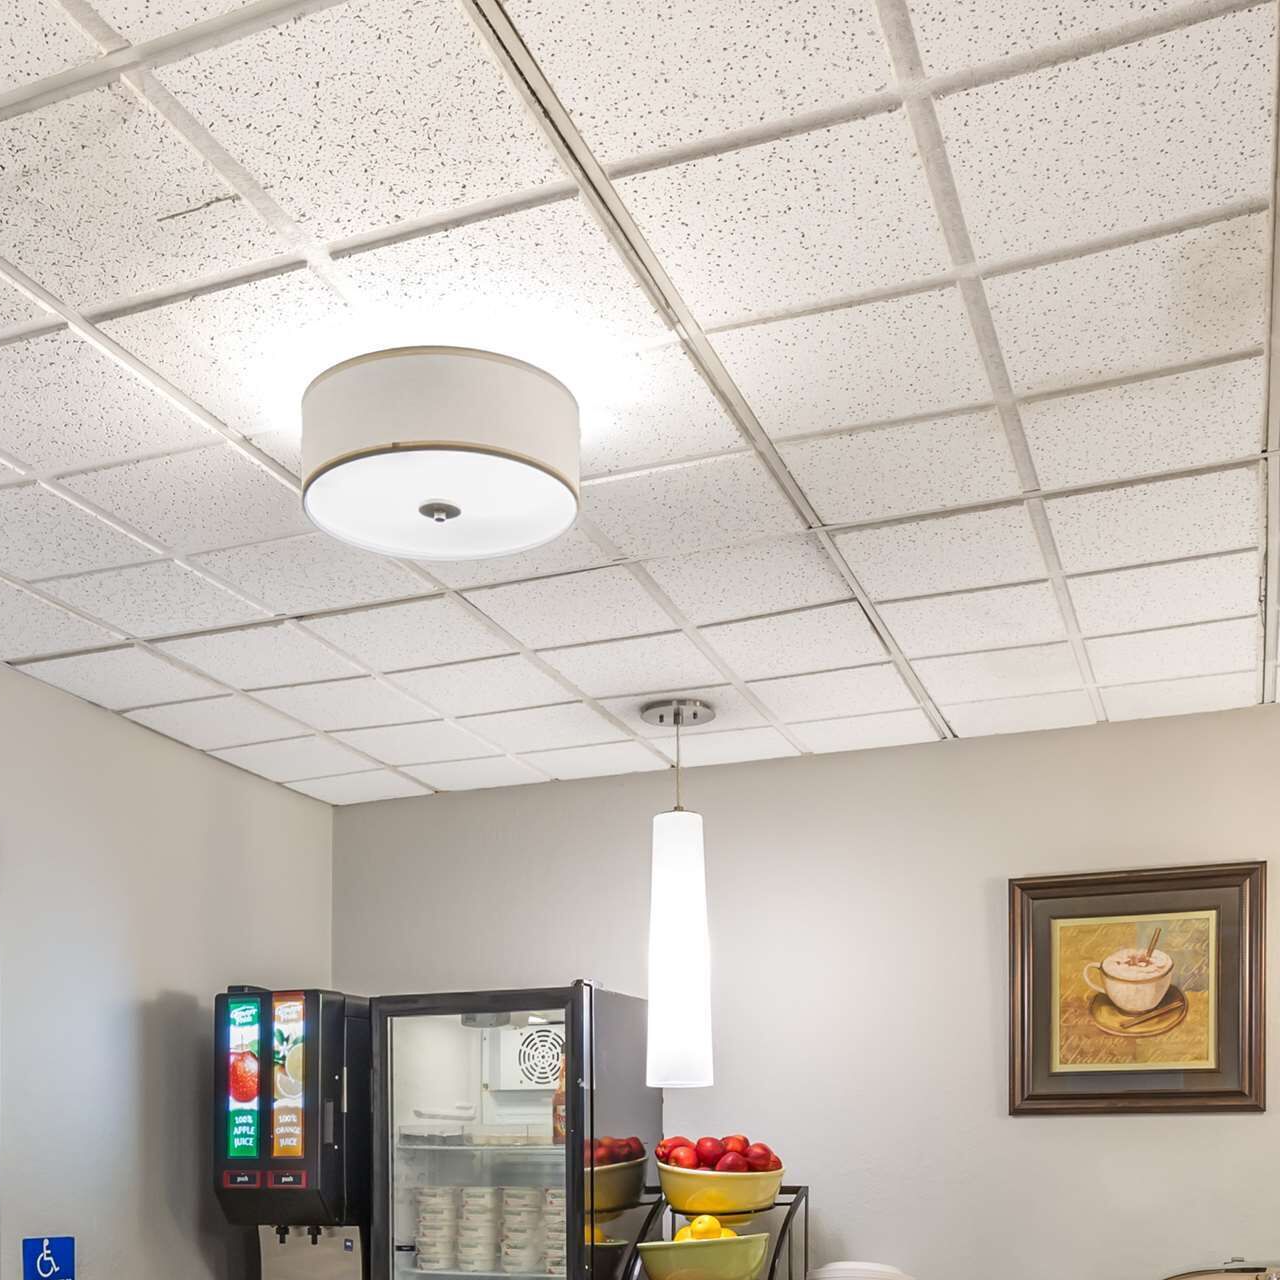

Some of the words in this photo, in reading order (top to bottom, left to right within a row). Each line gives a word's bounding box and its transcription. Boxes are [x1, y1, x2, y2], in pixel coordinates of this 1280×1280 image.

[233, 1126, 256, 1135] APPLE
[234, 1137, 254, 1148] JUICE
[279, 1137, 297, 1148] JUICE
